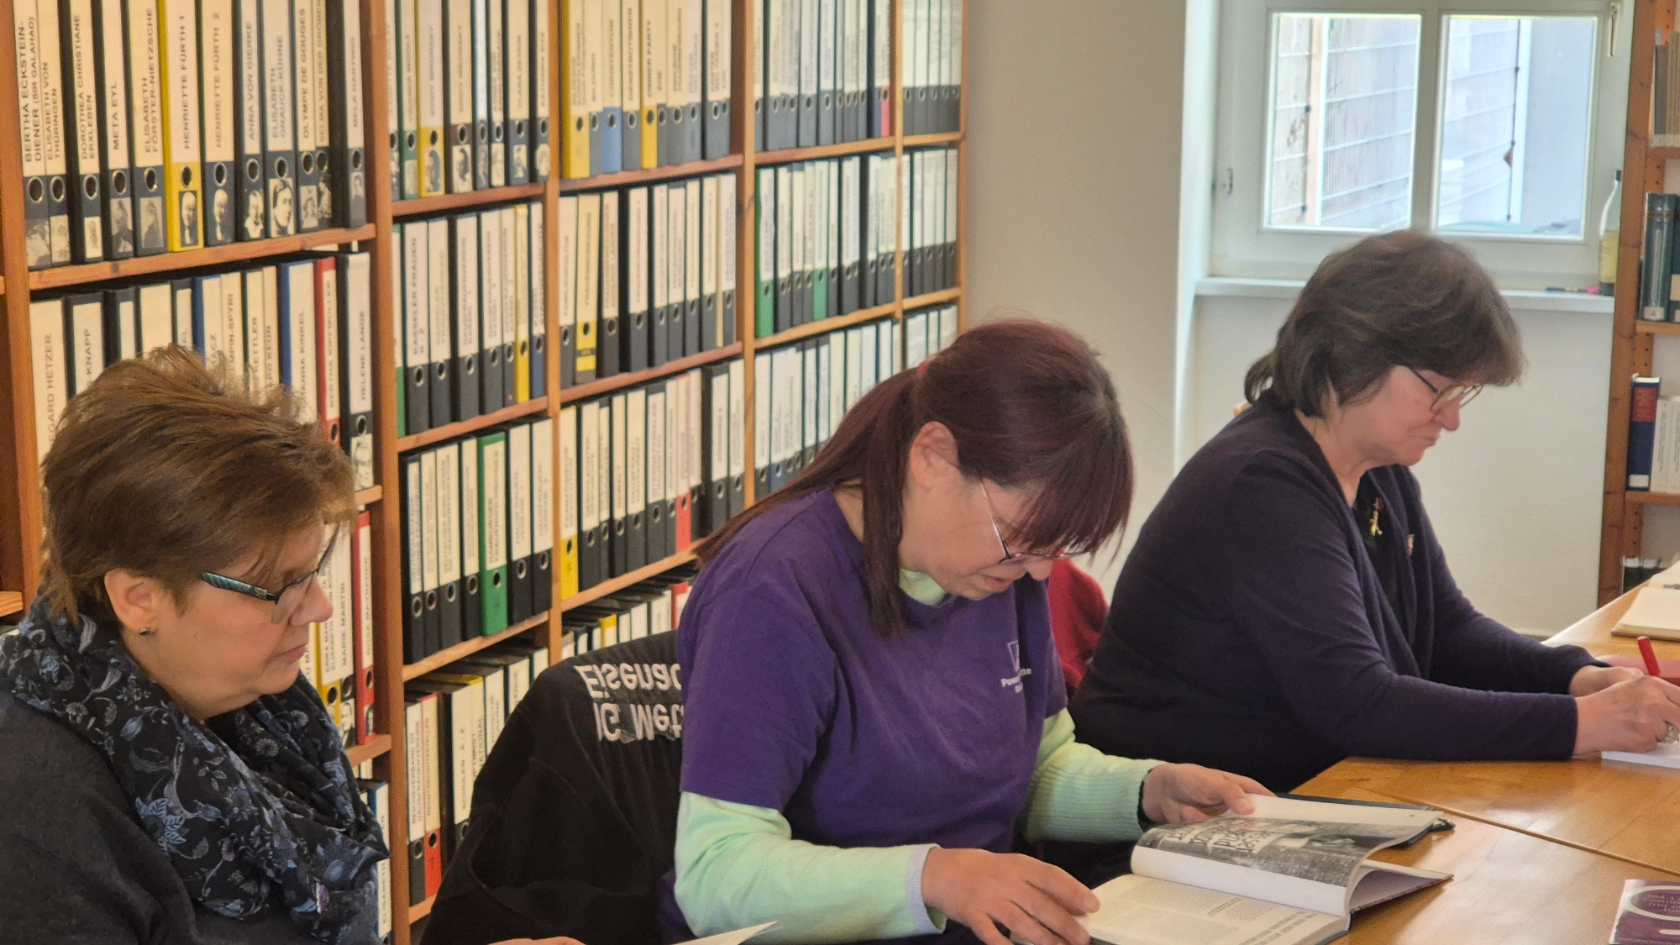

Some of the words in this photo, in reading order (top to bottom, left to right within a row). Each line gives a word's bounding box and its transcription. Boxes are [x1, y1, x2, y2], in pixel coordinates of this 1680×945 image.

[213, 12, 219, 20] 2
[299, 9, 307, 62] GOUGES
[18, 20, 29, 98] ECKSTEIN-
[27, 17, 38, 78] GALAHAD)
[42, 62, 50, 88] VON
[73, 15, 83, 88] CHRISTIANE
[178, 26, 186, 70] FÜRTH
[212, 27, 220, 70] FÜRTH
[300, 66, 307, 84] DE
[31, 81, 39, 105] (SIR
[110, 81, 118, 107] EYL
[147, 8, 158, 153] FÖRSTER-NIETZSCHE
[270, 68, 278, 138] ELISABETH
[22, 103, 33, 162] BERTHA
[32, 108, 41, 161] DIENER
[44, 92, 53, 160] ELISABETH
[50, 88, 60, 160] THÜRINGEN
[78, 92, 88, 160] DOROTHEA
[86, 95, 95, 159] ERXLEBEN
[141, 78, 150, 153] ELISABETH
[181, 74, 189, 150] HENRIETTE
[214, 74, 222, 148] HENRIETTE
[247, 104, 255, 141] ANNA
[302, 88, 310, 138] OLYMPE
[45, 334, 54, 389] HETZER
[47, 394, 56, 443] EGARD
